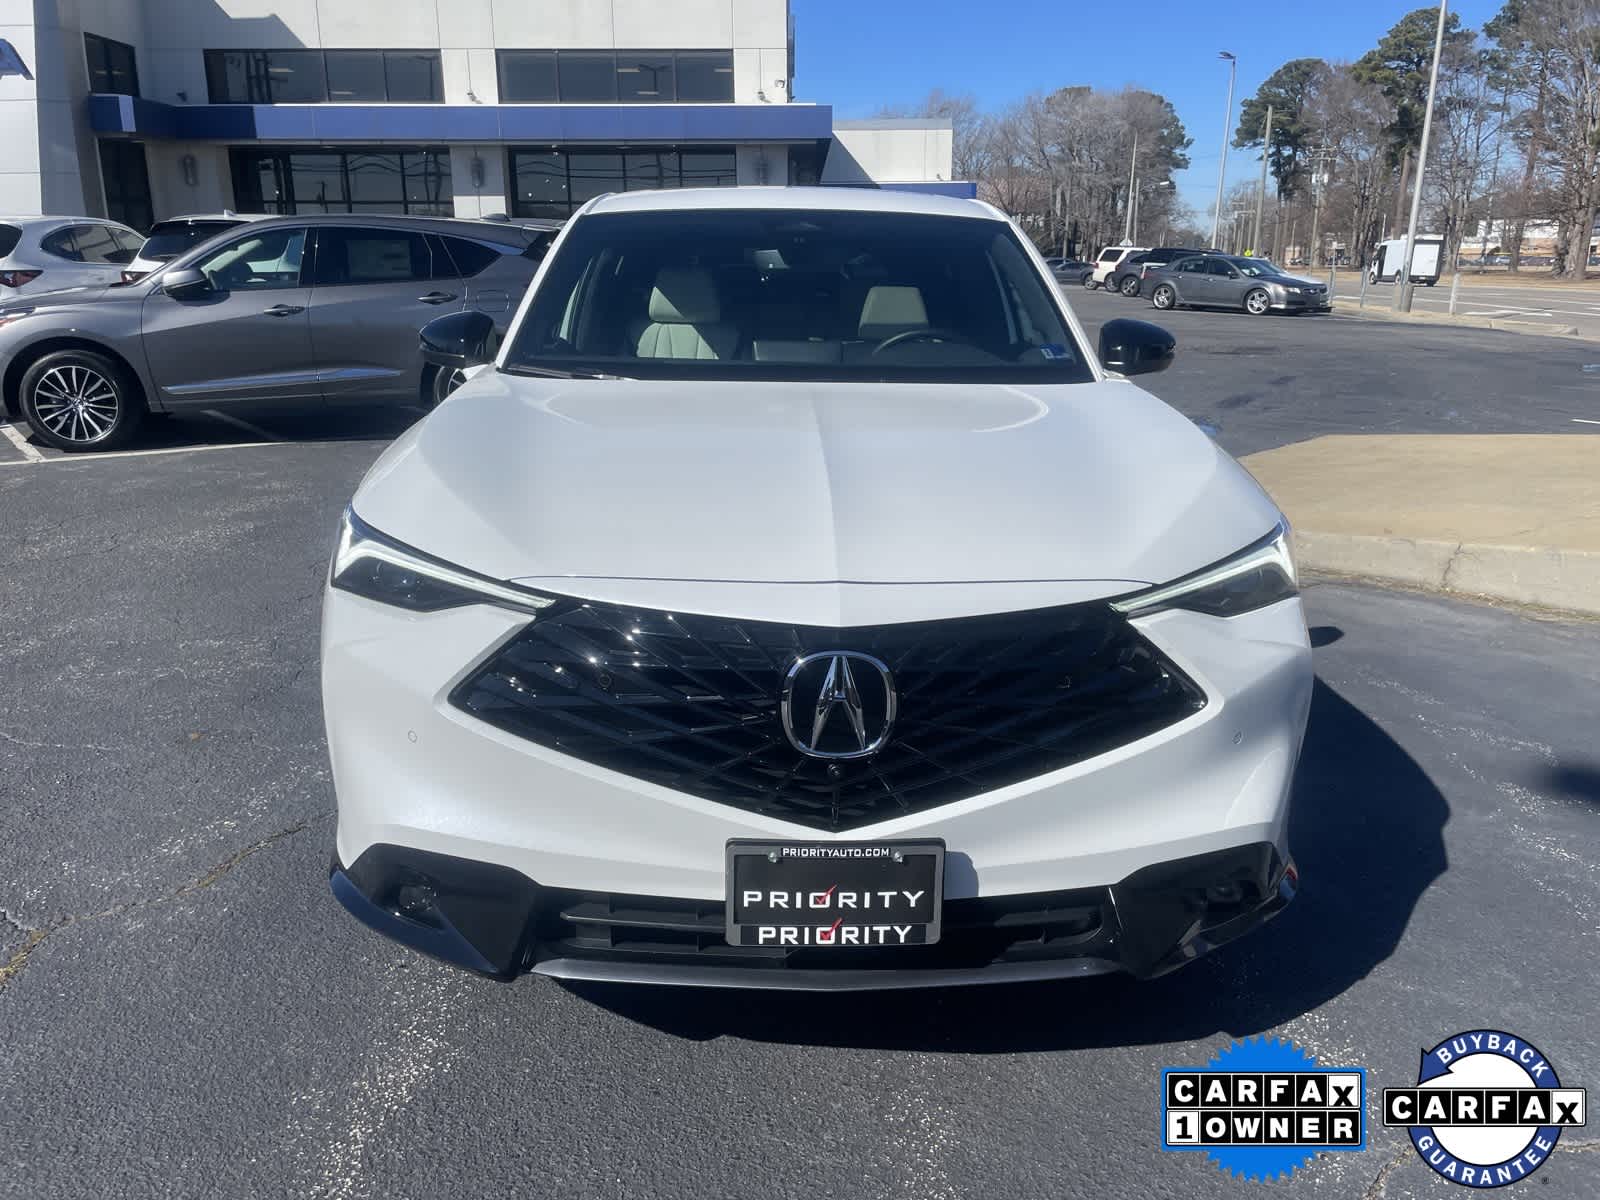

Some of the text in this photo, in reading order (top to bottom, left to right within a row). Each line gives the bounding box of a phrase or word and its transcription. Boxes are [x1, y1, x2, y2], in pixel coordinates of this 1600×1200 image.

[782, 847, 890, 857] PRIORITYAUTO.COM
[743, 890, 925, 909] PRIORITY
[758, 925, 913, 945] PRIORITY
